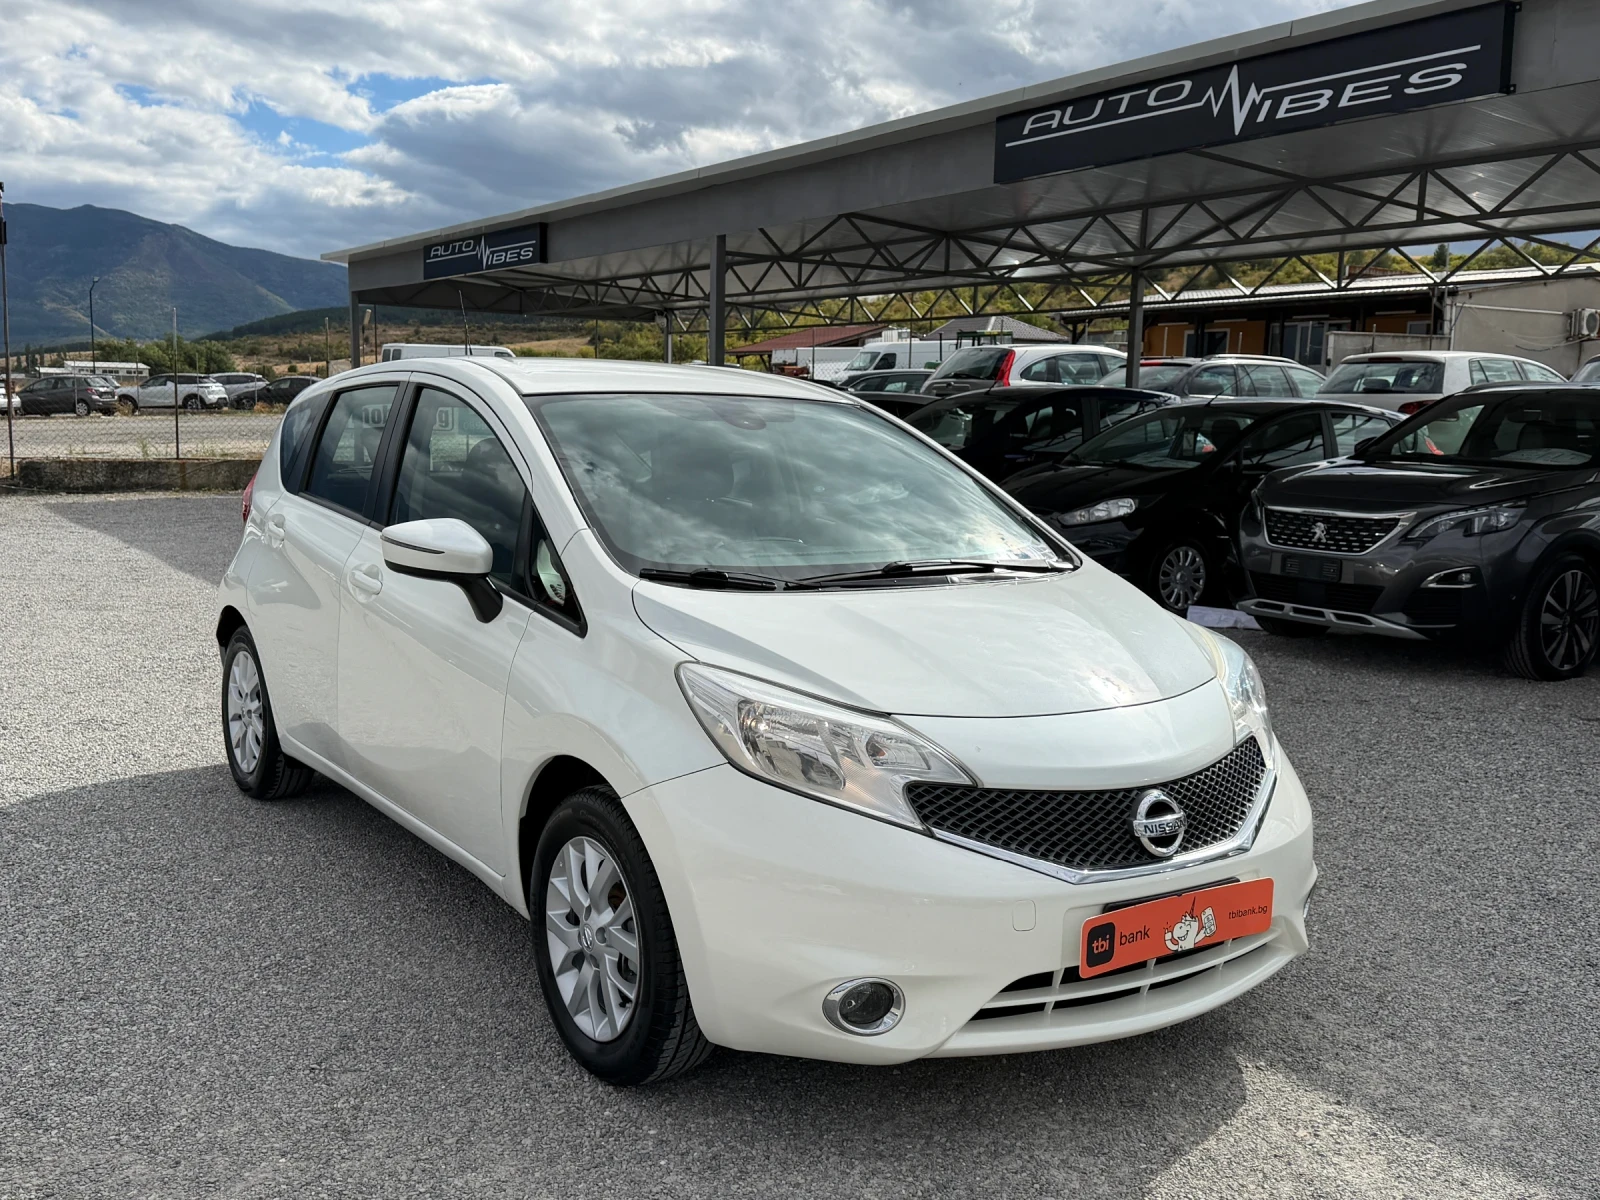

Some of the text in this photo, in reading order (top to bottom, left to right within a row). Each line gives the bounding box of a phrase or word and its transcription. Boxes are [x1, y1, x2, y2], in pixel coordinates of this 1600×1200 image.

[1022, 80, 1193, 135] AUTO
[430, 239, 474, 258] AUTO
[1143, 819, 1186, 834] NISSAN
[1228, 905, 1268, 920] tbibank.bg
[1092, 924, 1151, 954] tbi bank
